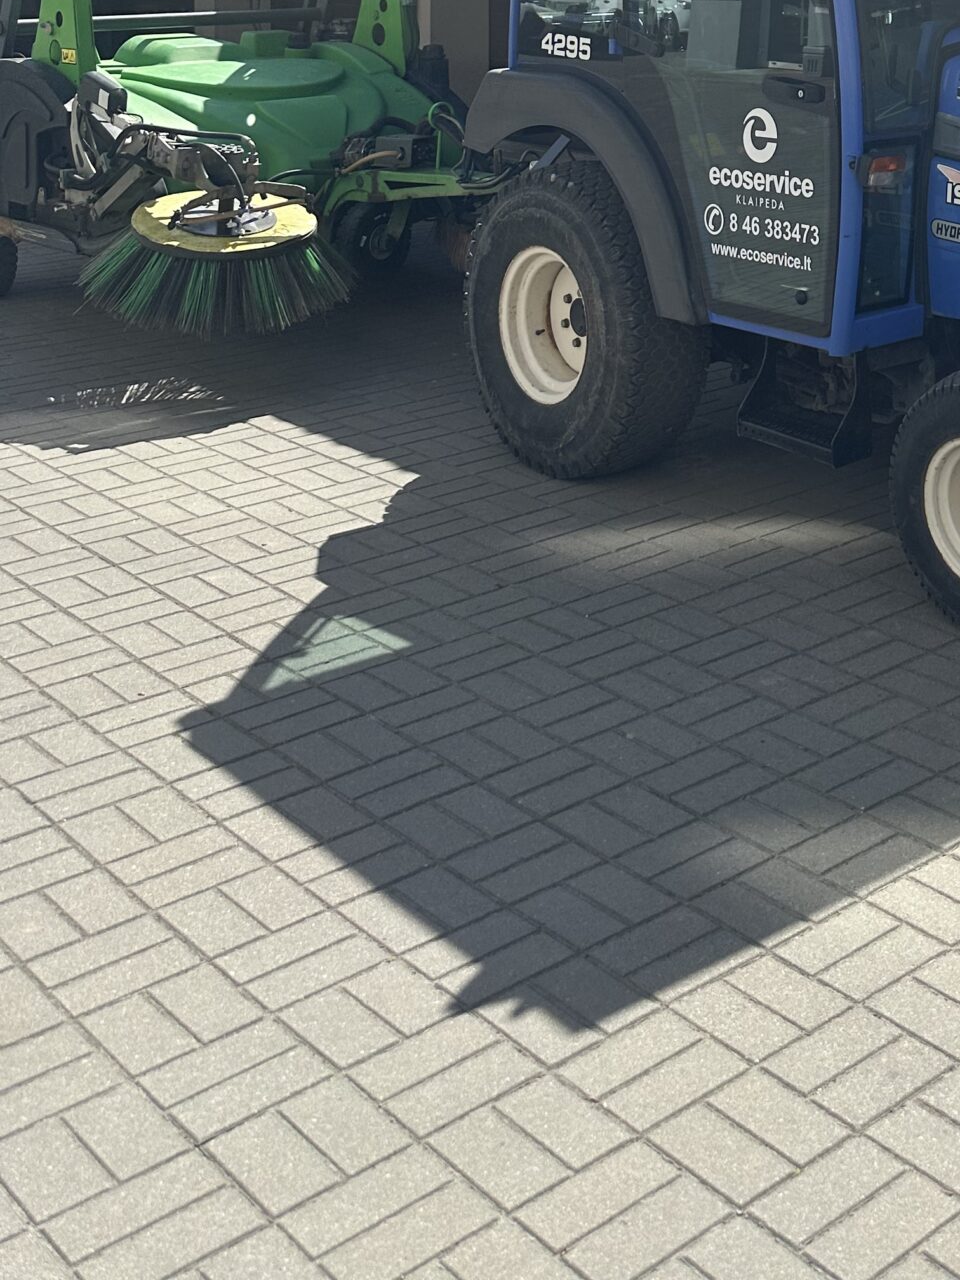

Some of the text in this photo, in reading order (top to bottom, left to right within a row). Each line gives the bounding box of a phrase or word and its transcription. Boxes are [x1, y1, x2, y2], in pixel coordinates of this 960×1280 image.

[541, 32, 592, 61] 4295
[708, 166, 814, 198] ecoservice
[735, 194, 785, 210] KLAIPEDA
[729, 212, 820, 246] 8 46 383473
[711, 242, 812, 271] www.ecoservice.lt
